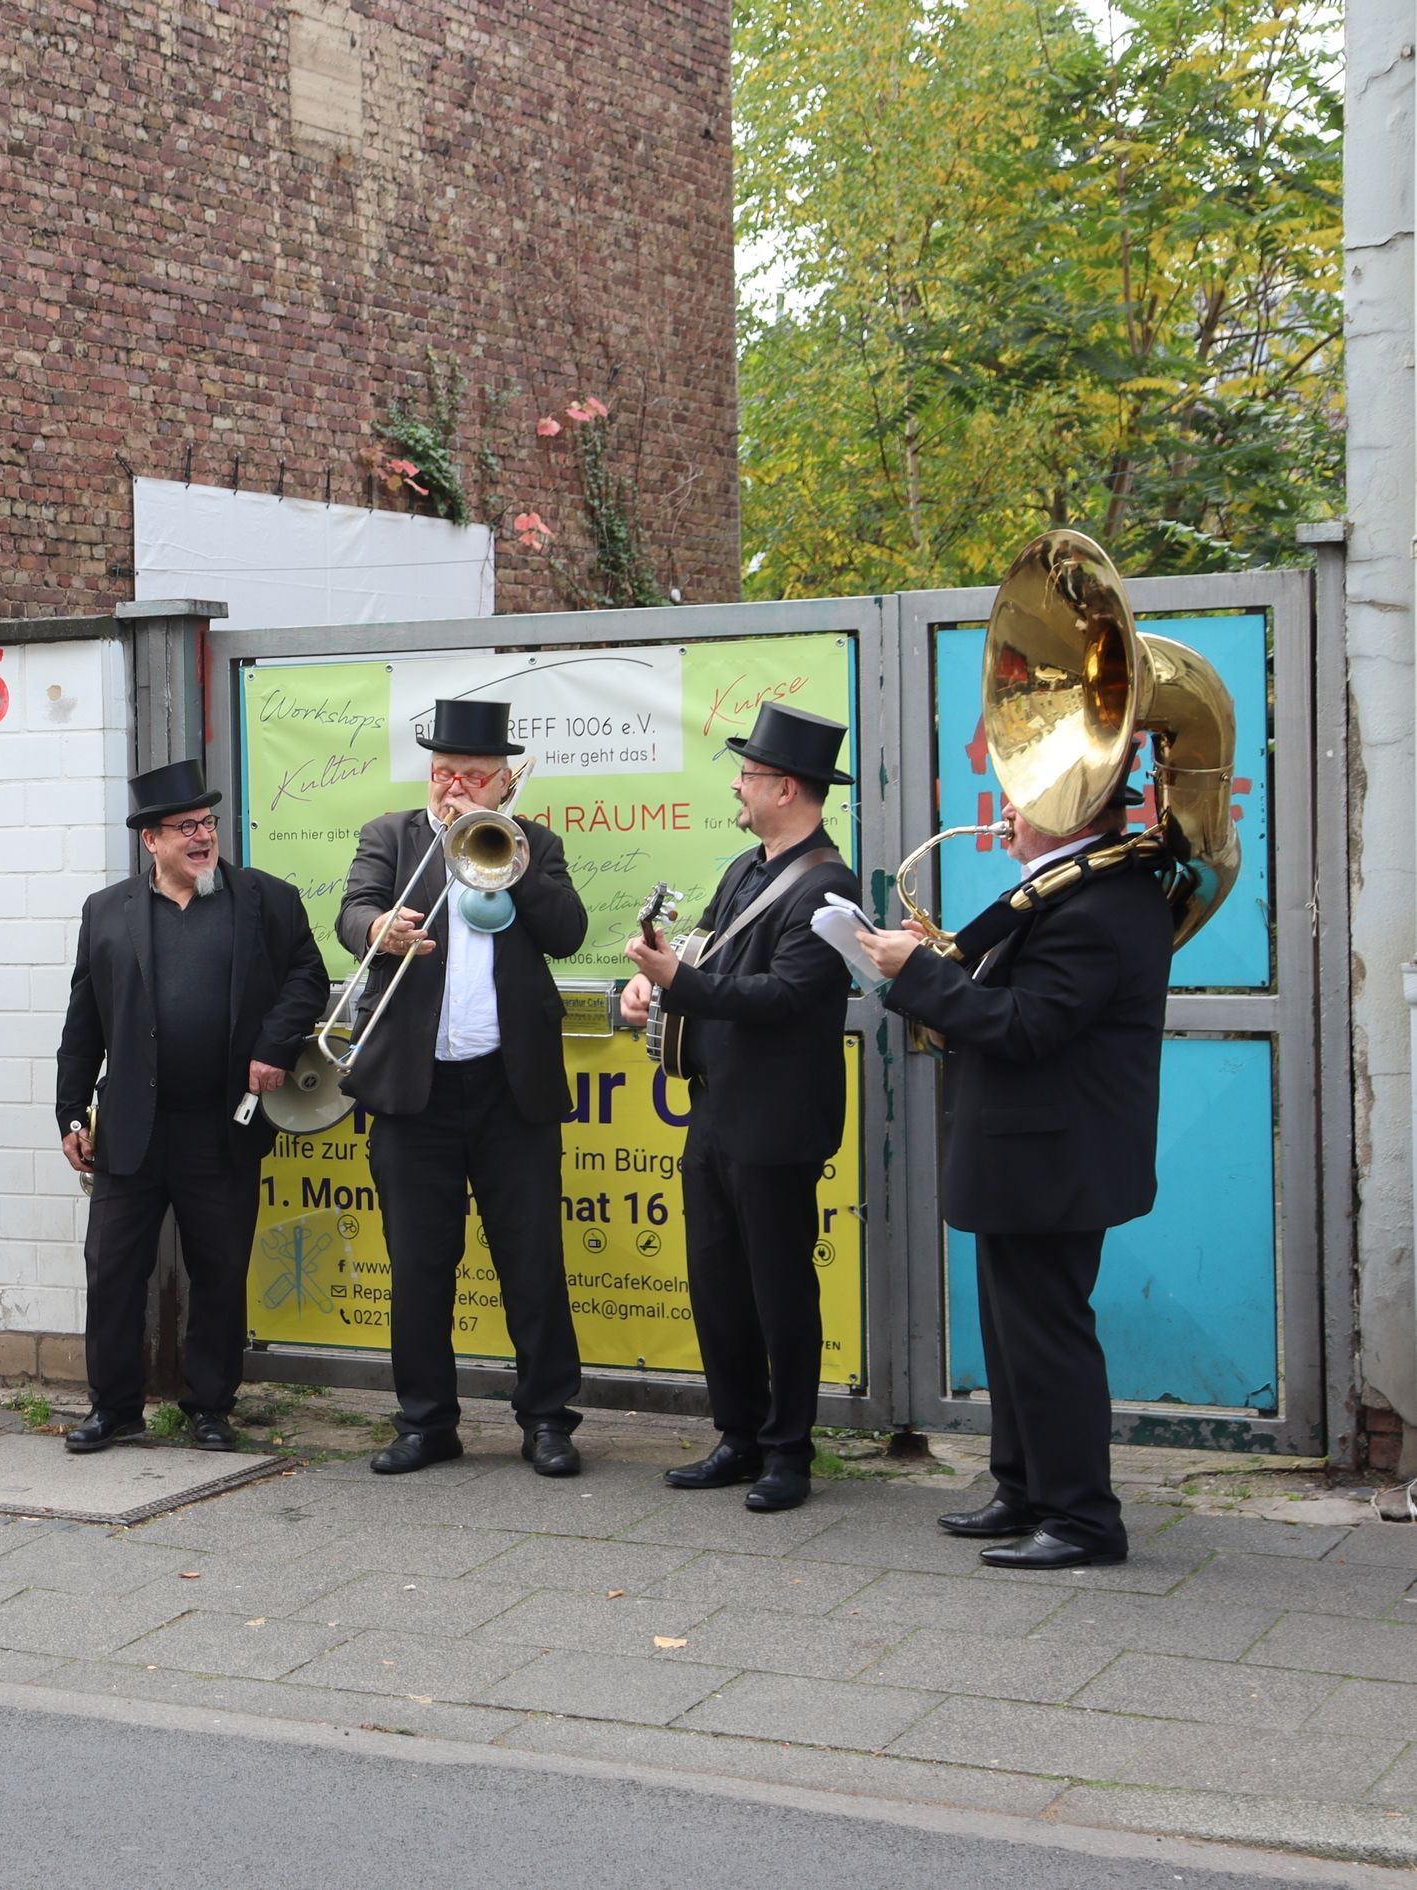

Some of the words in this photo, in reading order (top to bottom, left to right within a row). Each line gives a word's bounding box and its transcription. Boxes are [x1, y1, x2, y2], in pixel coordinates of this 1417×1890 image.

[260, 689, 386, 748] Workshops
[703, 673, 810, 736] Kurse
[566, 716, 614, 738] 1006
[621, 712, 657, 736] e.V.
[545, 750, 577, 765] Hier
[580, 748, 615, 768] geht
[270, 754, 378, 812] Kultur
[565, 801, 692, 834] RÄUME
[704, 815, 724, 830] für
[268, 829, 298, 842] denn
[301, 828, 324, 841] hier
[327, 828, 350, 843] gibt
[321, 1142, 358, 1161] zur
[575, 1146, 605, 1171] im
[261, 1175, 290, 1207] 1.
[623, 1191, 669, 1226] 16
